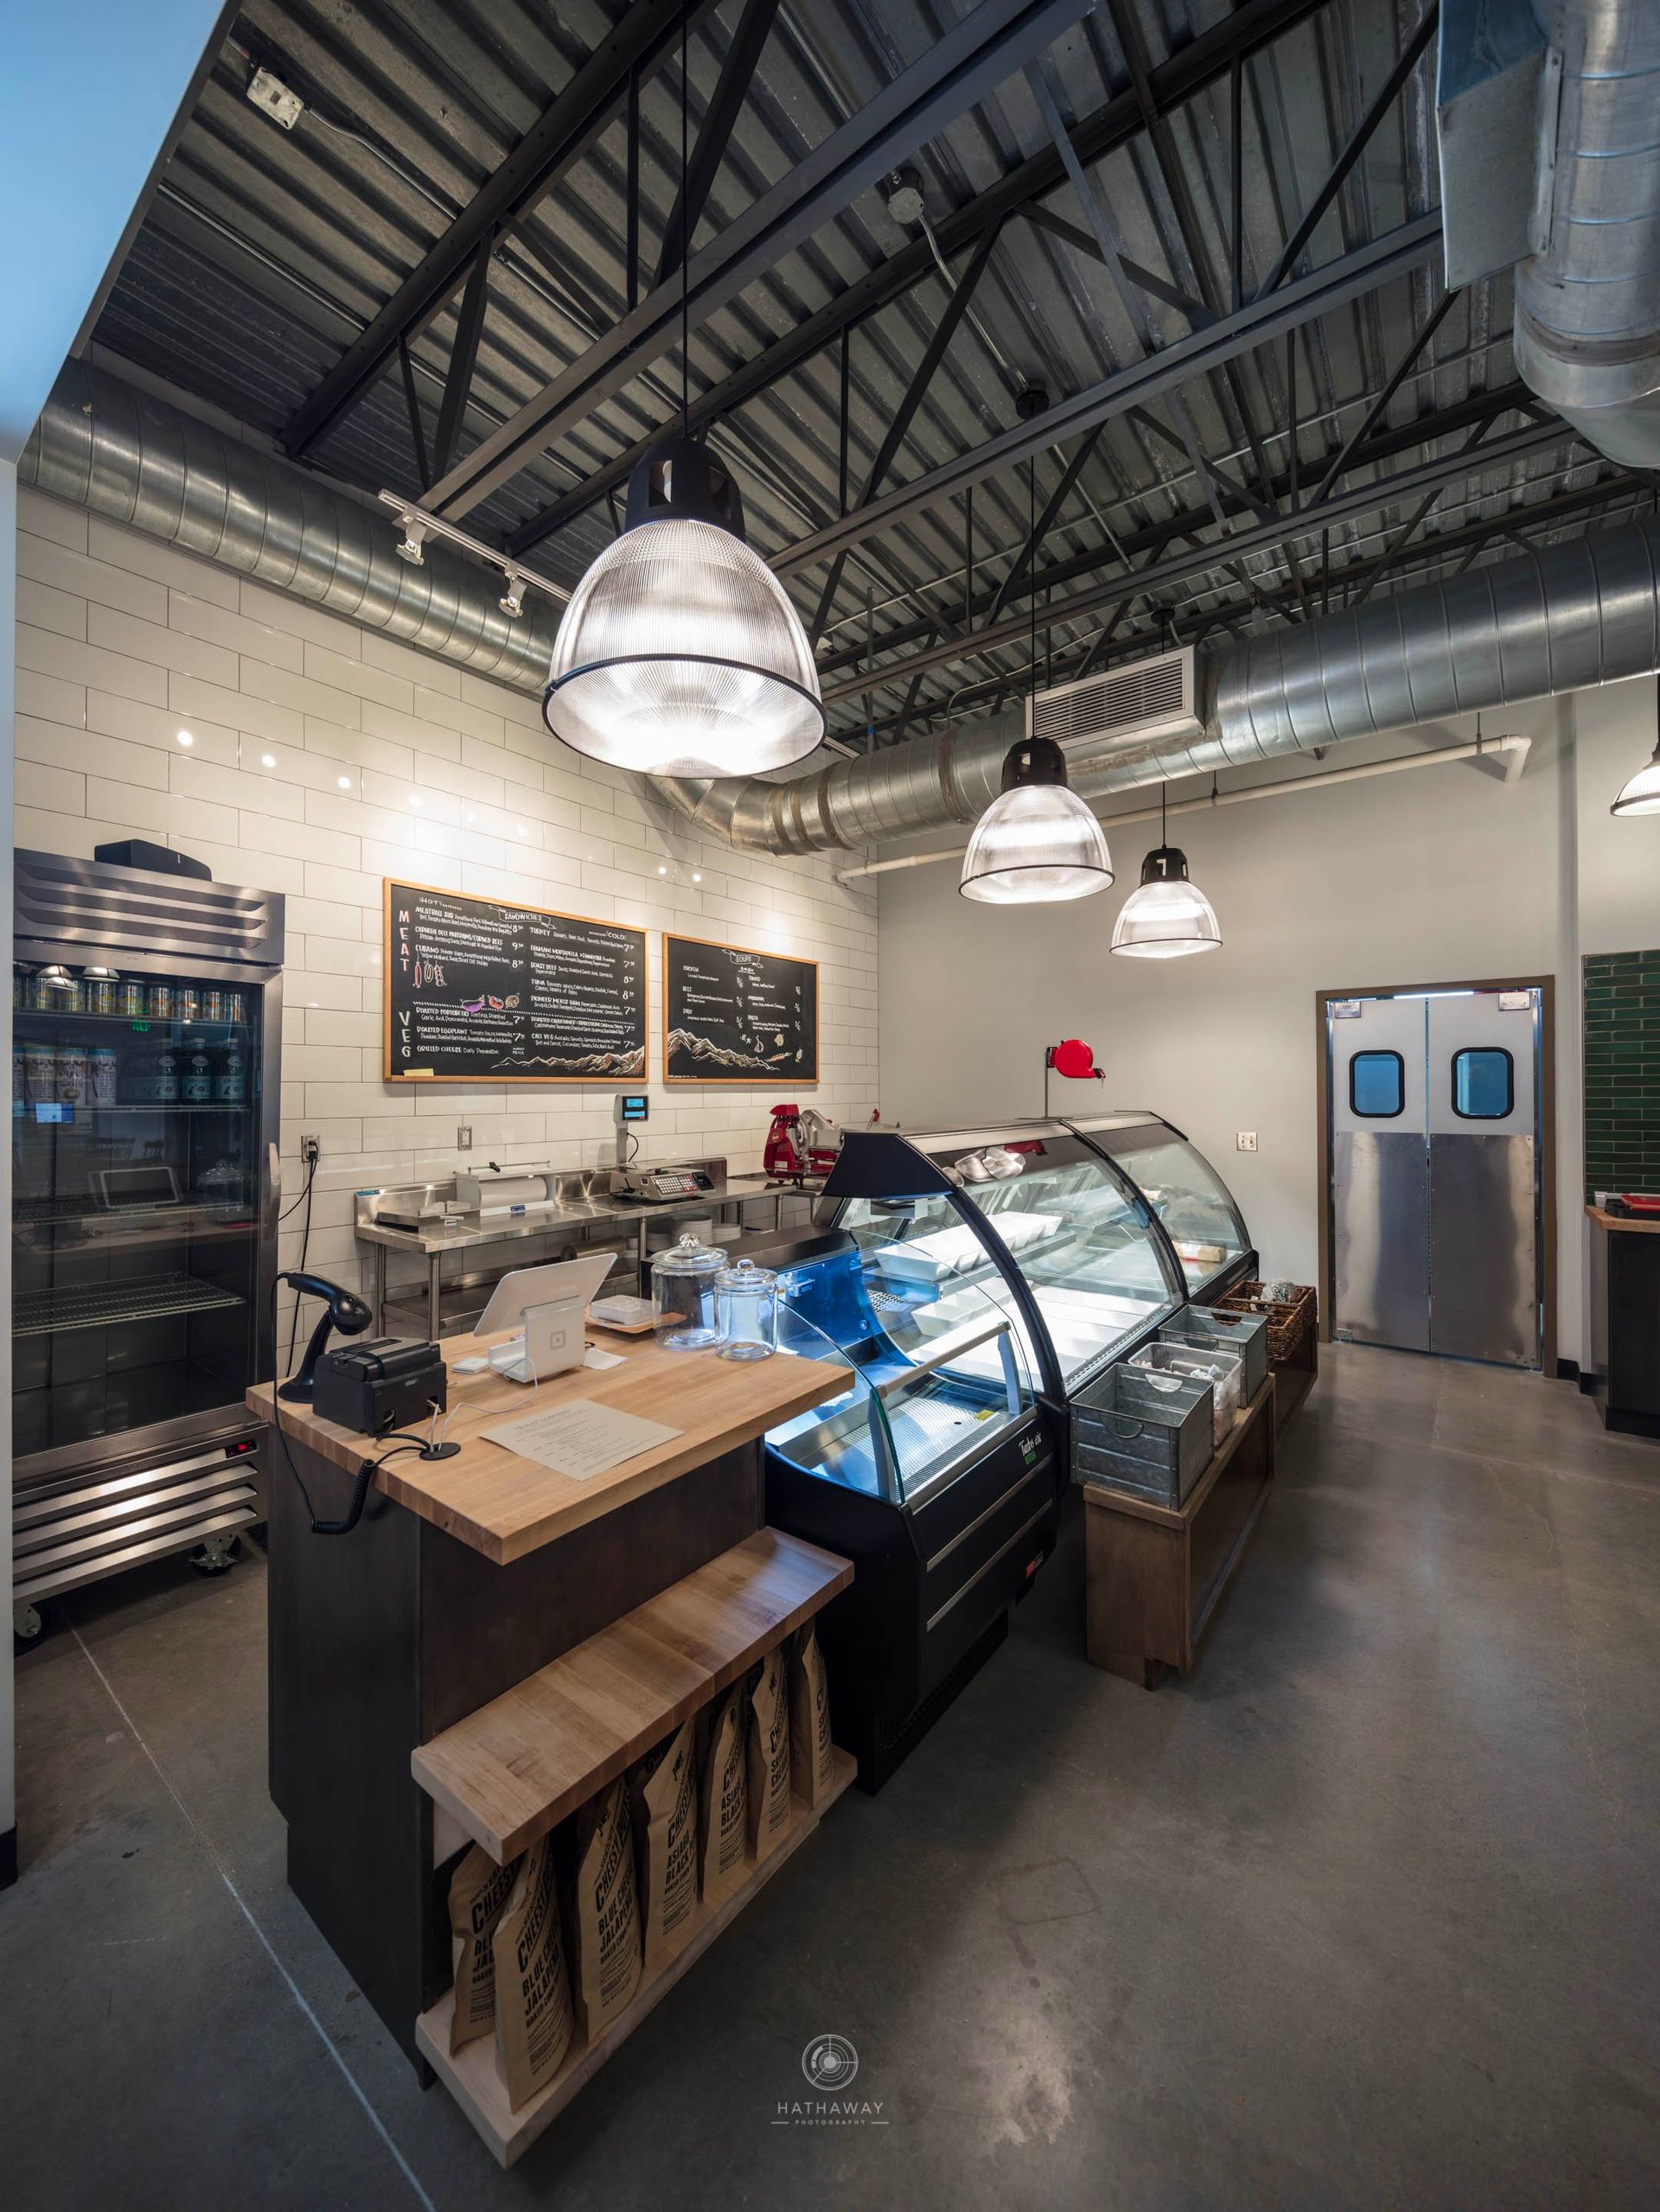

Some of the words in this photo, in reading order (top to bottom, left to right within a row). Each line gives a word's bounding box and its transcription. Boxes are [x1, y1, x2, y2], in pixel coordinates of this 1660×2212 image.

[416, 907, 443, 917] MEATBALL
[505, 912, 543, 921] SANDWICHES
[530, 927, 551, 936] TURKEY
[415, 944, 439, 953] CUBANO
[667, 1829, 690, 1869] ASIAGO
[666, 1852, 690, 1884] BLACK
[598, 1896, 618, 1935] BLUE
[522, 1954, 544, 1998] BLUE
